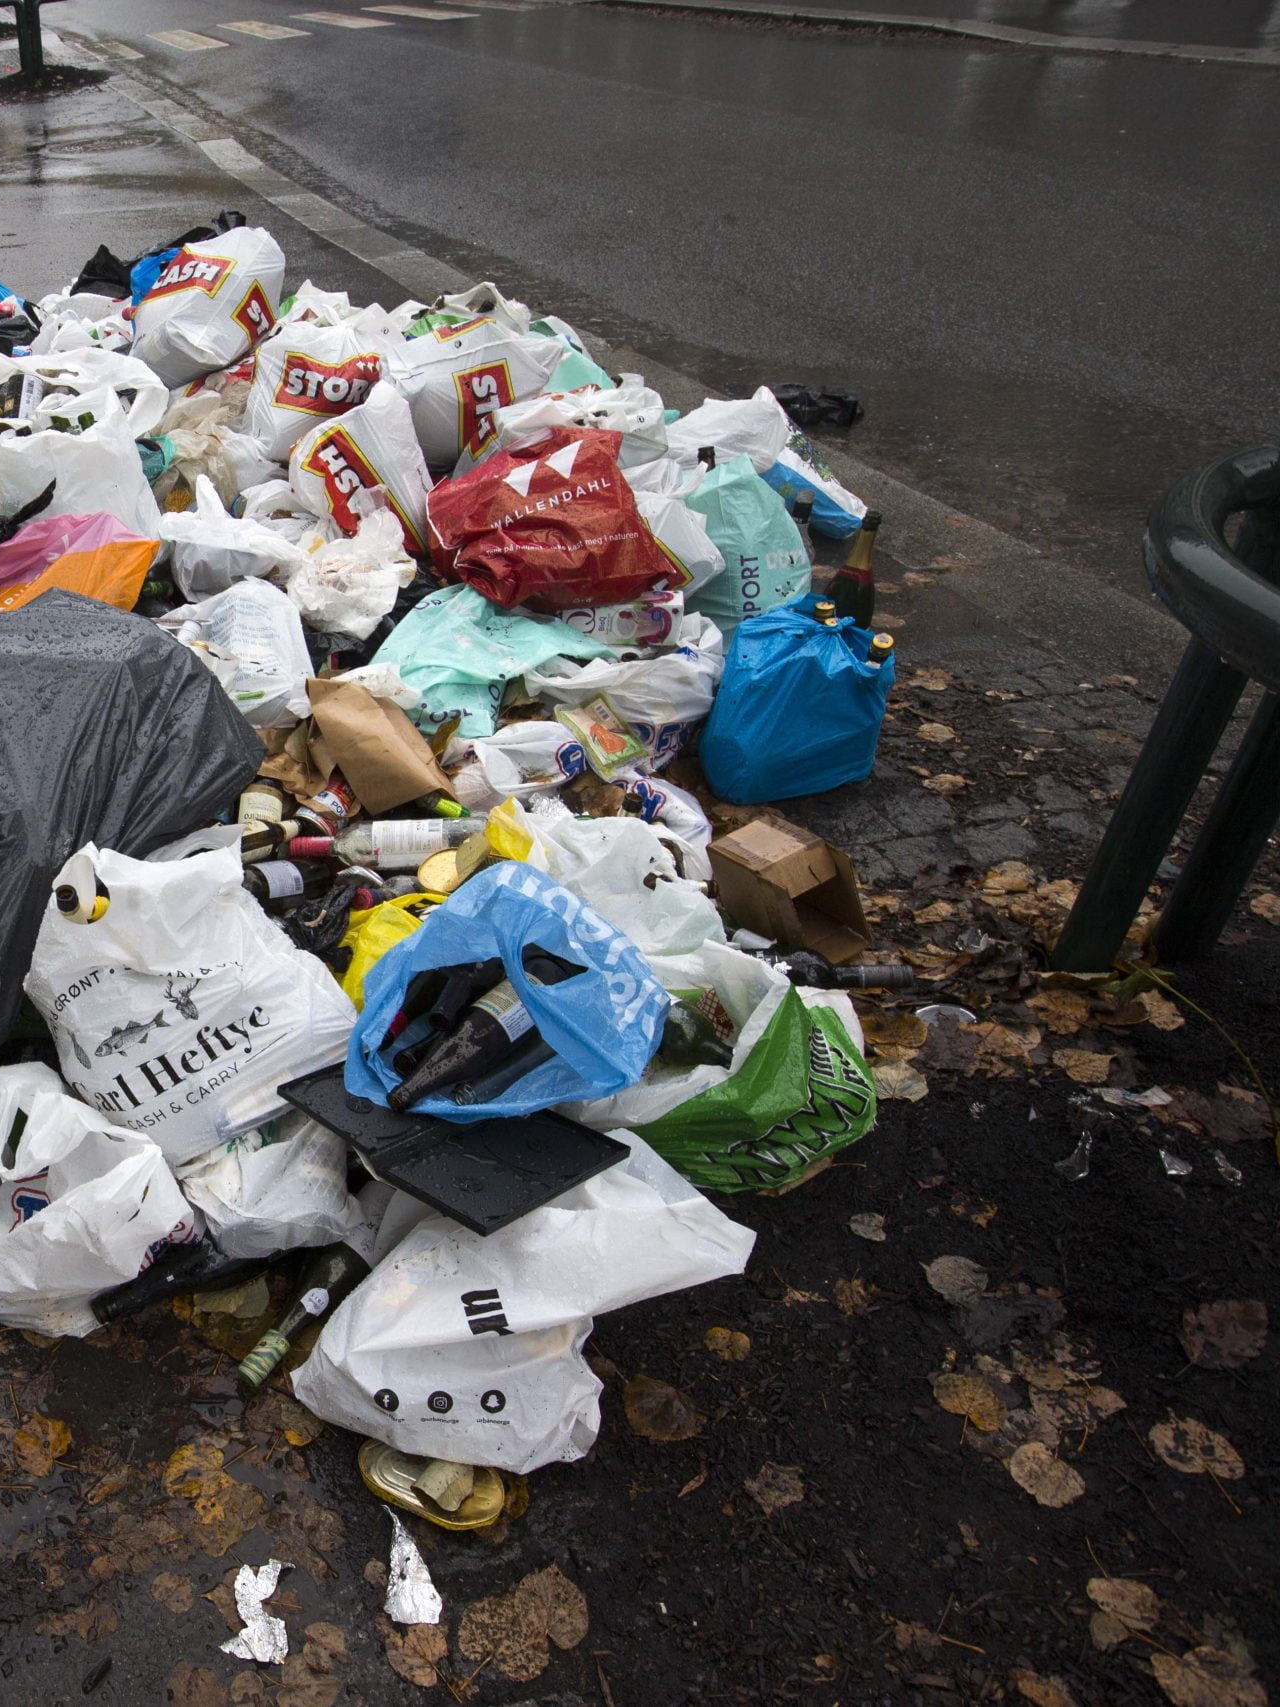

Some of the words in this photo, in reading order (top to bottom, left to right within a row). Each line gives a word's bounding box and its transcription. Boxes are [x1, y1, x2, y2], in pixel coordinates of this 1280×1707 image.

[152, 259, 221, 290] CASH
[490, 477, 612, 531] WALLENDAHL
[585, 537, 603, 545] meg
[609, 532, 639, 541] naturen
[54, 969, 102, 1013] GRØNT
[136, 1006, 270, 1098] Heftye
[127, 1110, 167, 1131] CASH
[169, 1102, 184, 1114] &
[186, 1061, 241, 1105] CARRY
